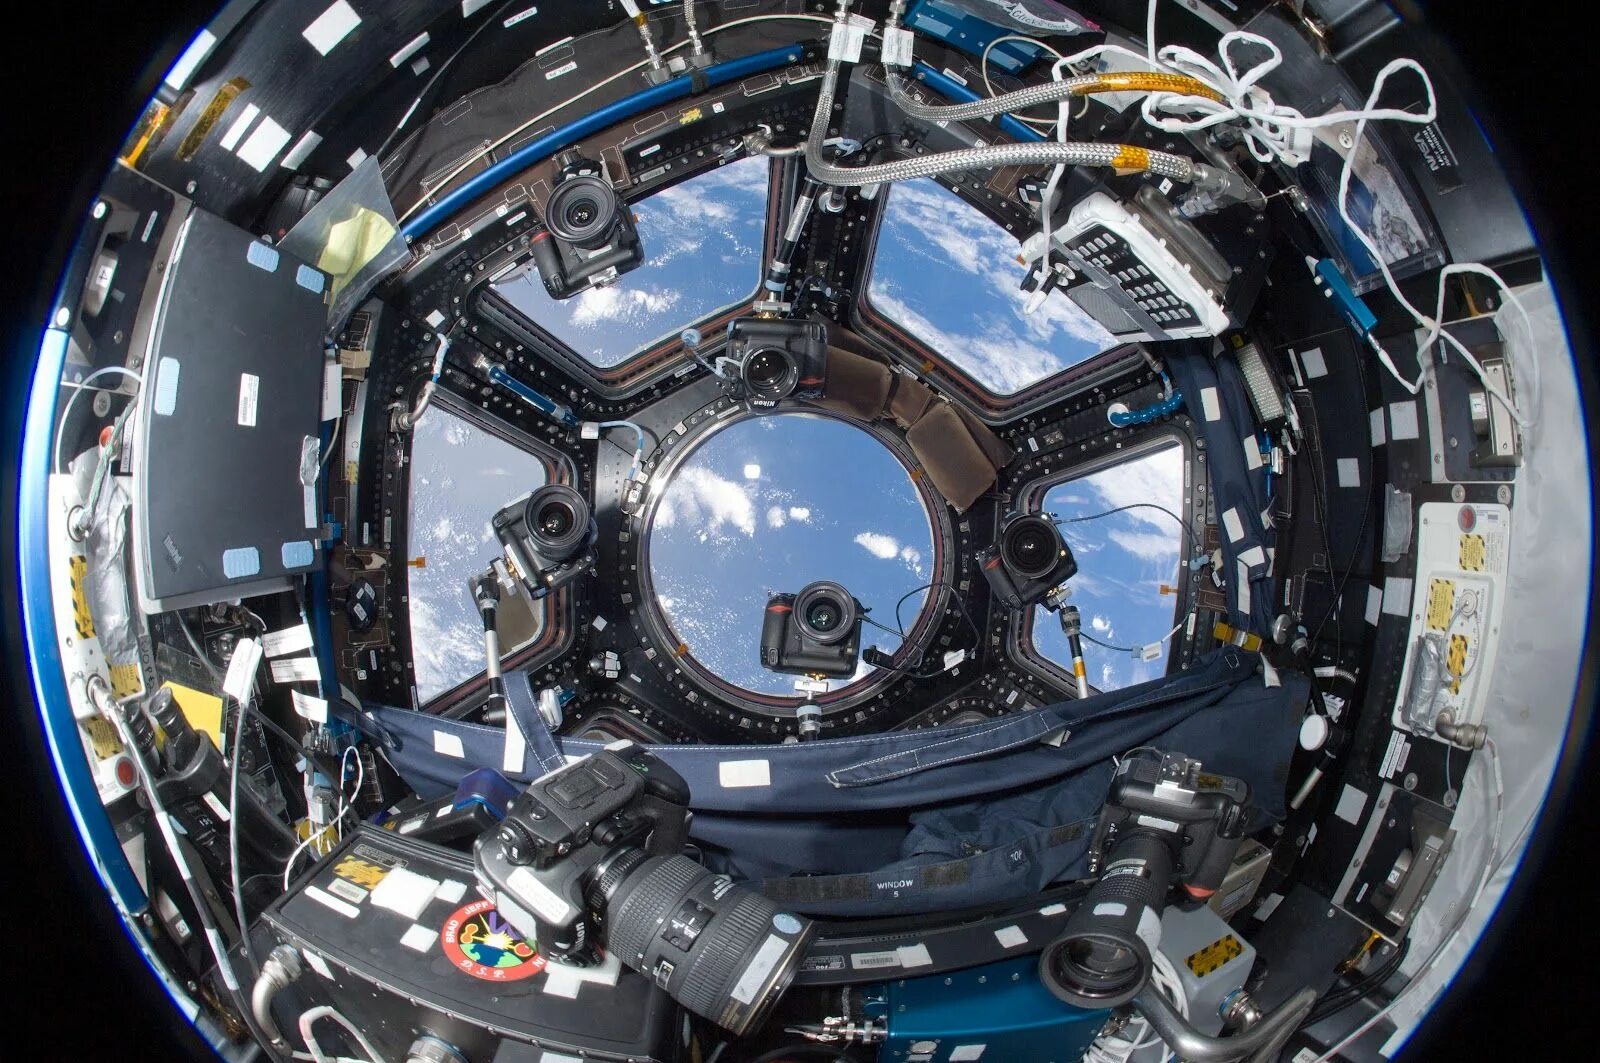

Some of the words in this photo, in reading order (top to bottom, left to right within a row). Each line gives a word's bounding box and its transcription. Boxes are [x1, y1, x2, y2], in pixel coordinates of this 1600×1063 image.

[1413, 132, 1439, 171] NASA
[1010, 850, 1023, 862] TOP
[876, 879, 914, 890] WINDOW
[893, 890, 899, 898] 5
[464, 900, 489, 915] JEFF
[445, 919, 459, 944] BRAD
